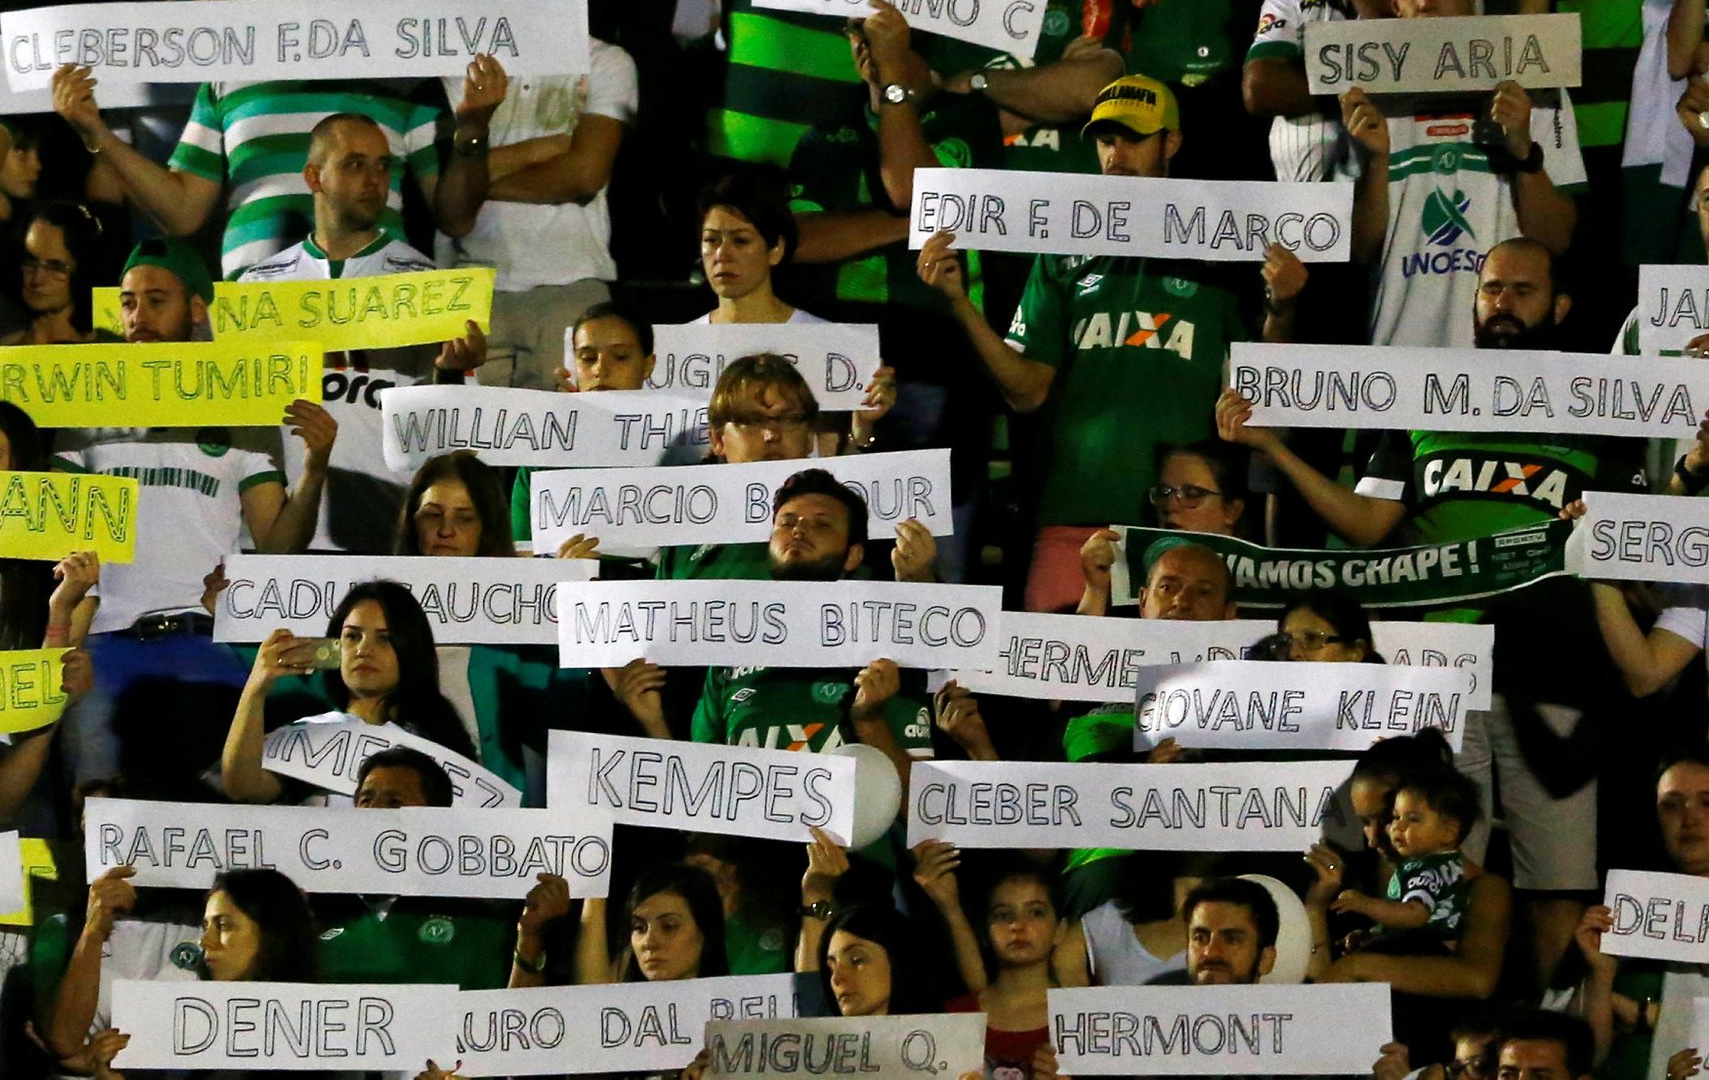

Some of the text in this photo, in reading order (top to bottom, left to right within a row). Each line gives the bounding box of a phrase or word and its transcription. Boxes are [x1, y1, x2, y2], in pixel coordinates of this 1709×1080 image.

[10, 24, 256, 74] CLEBERSON
[395, 16, 519, 58] SILVA
[1002, 0, 1035, 40] C
[1318, 33, 1550, 85] SISY ARIA
[918, 191, 1341, 252] EDIR F. DE MARCO
[297, 275, 474, 329] SUAREZ
[1650, 287, 1709, 330] JA
[1074, 309, 1195, 361] AIXA
[141, 353, 308, 401] TUMIRI
[1235, 364, 1397, 413] BRUNO
[1492, 375, 1554, 419] DA
[1567, 376, 1697, 427] SILVA
[392, 406, 578, 454] WILLIAN
[538, 482, 719, 530] MARCIO
[1423, 457, 1569, 510] CAIXA
[226, 577, 558, 625] CADU AUCH
[574, 600, 987, 649] MATHEUS BITECO
[1135, 688, 1461, 734] GIOVANE KLEIN
[586, 747, 833, 827] KEMPES
[917, 781, 1346, 830] CLEBER SANTANA
[98, 823, 277, 871] RAFAEL
[299, 828, 343, 871] C.
[373, 829, 609, 880] GOBBATO
[173, 995, 396, 1057] DENER
[457, 1006, 566, 1053] URO
[600, 1001, 692, 1049] DAL
[1056, 1012, 1293, 1057] HERMONT
[711, 1028, 948, 1076] MIGUEL Q.
